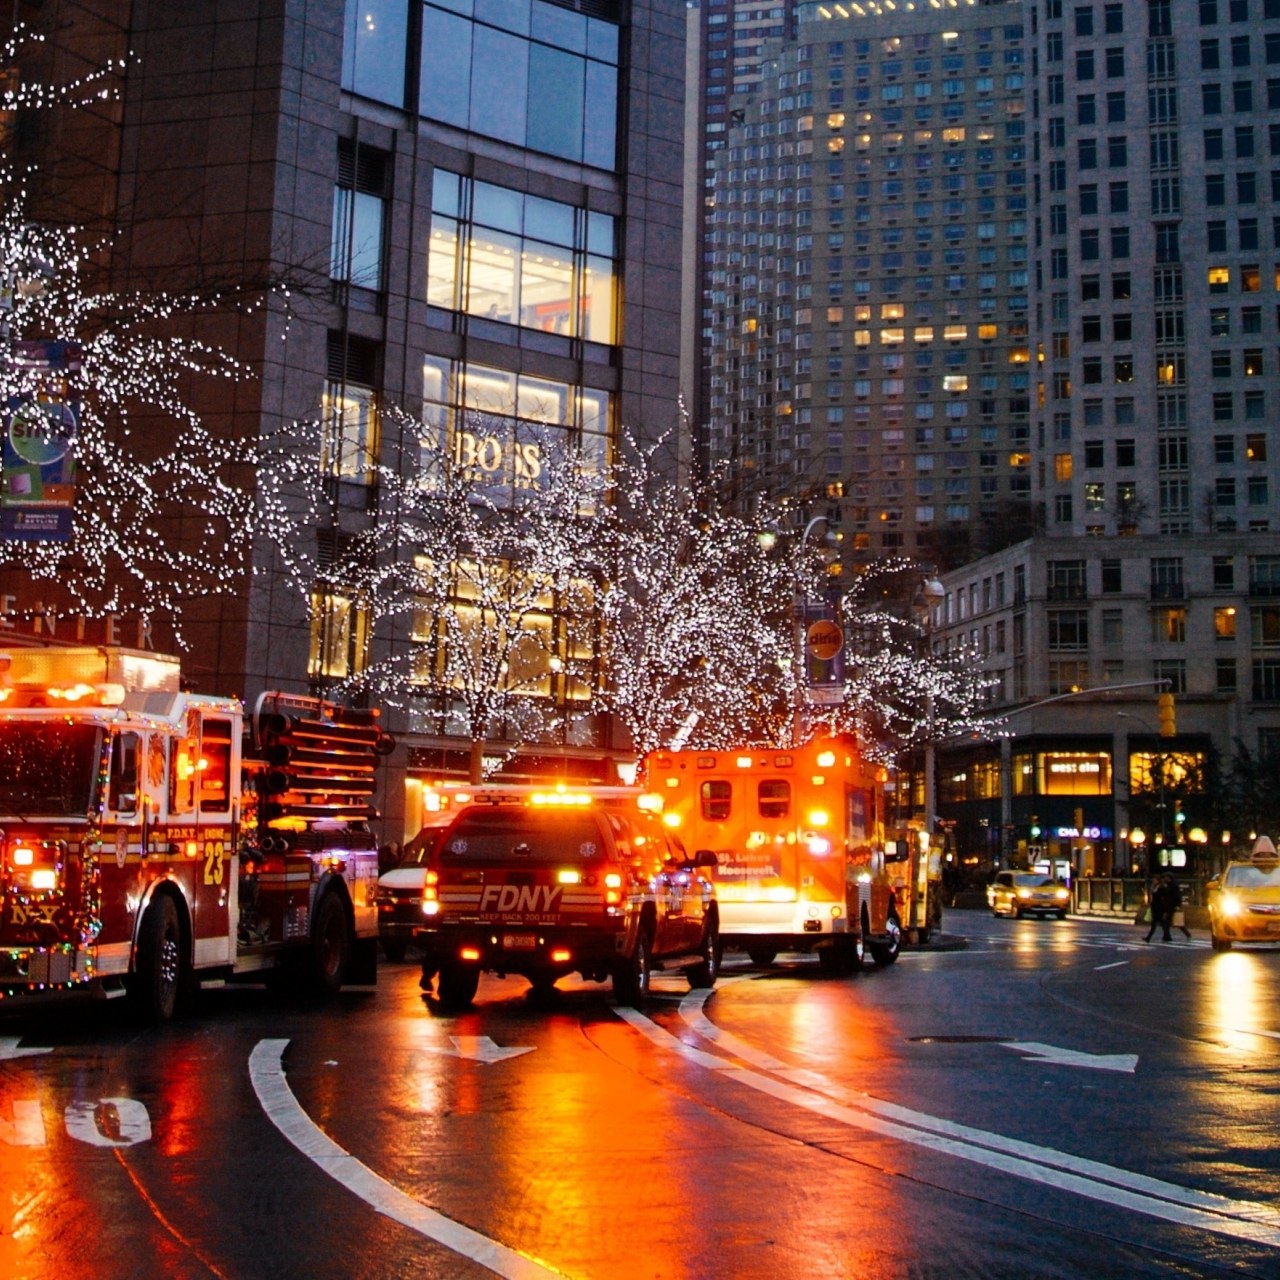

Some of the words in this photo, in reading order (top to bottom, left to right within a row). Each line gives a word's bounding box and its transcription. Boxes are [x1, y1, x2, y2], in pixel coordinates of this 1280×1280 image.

[1058, 827, 1090, 837] CHAE
[204, 841, 224, 886] 23
[479, 884, 564, 912] FDNY
[479, 912, 500, 921] KEEP
[502, 913, 523, 921] BACK
[524, 913, 540, 921] 200
[542, 913, 562, 922] FEET
